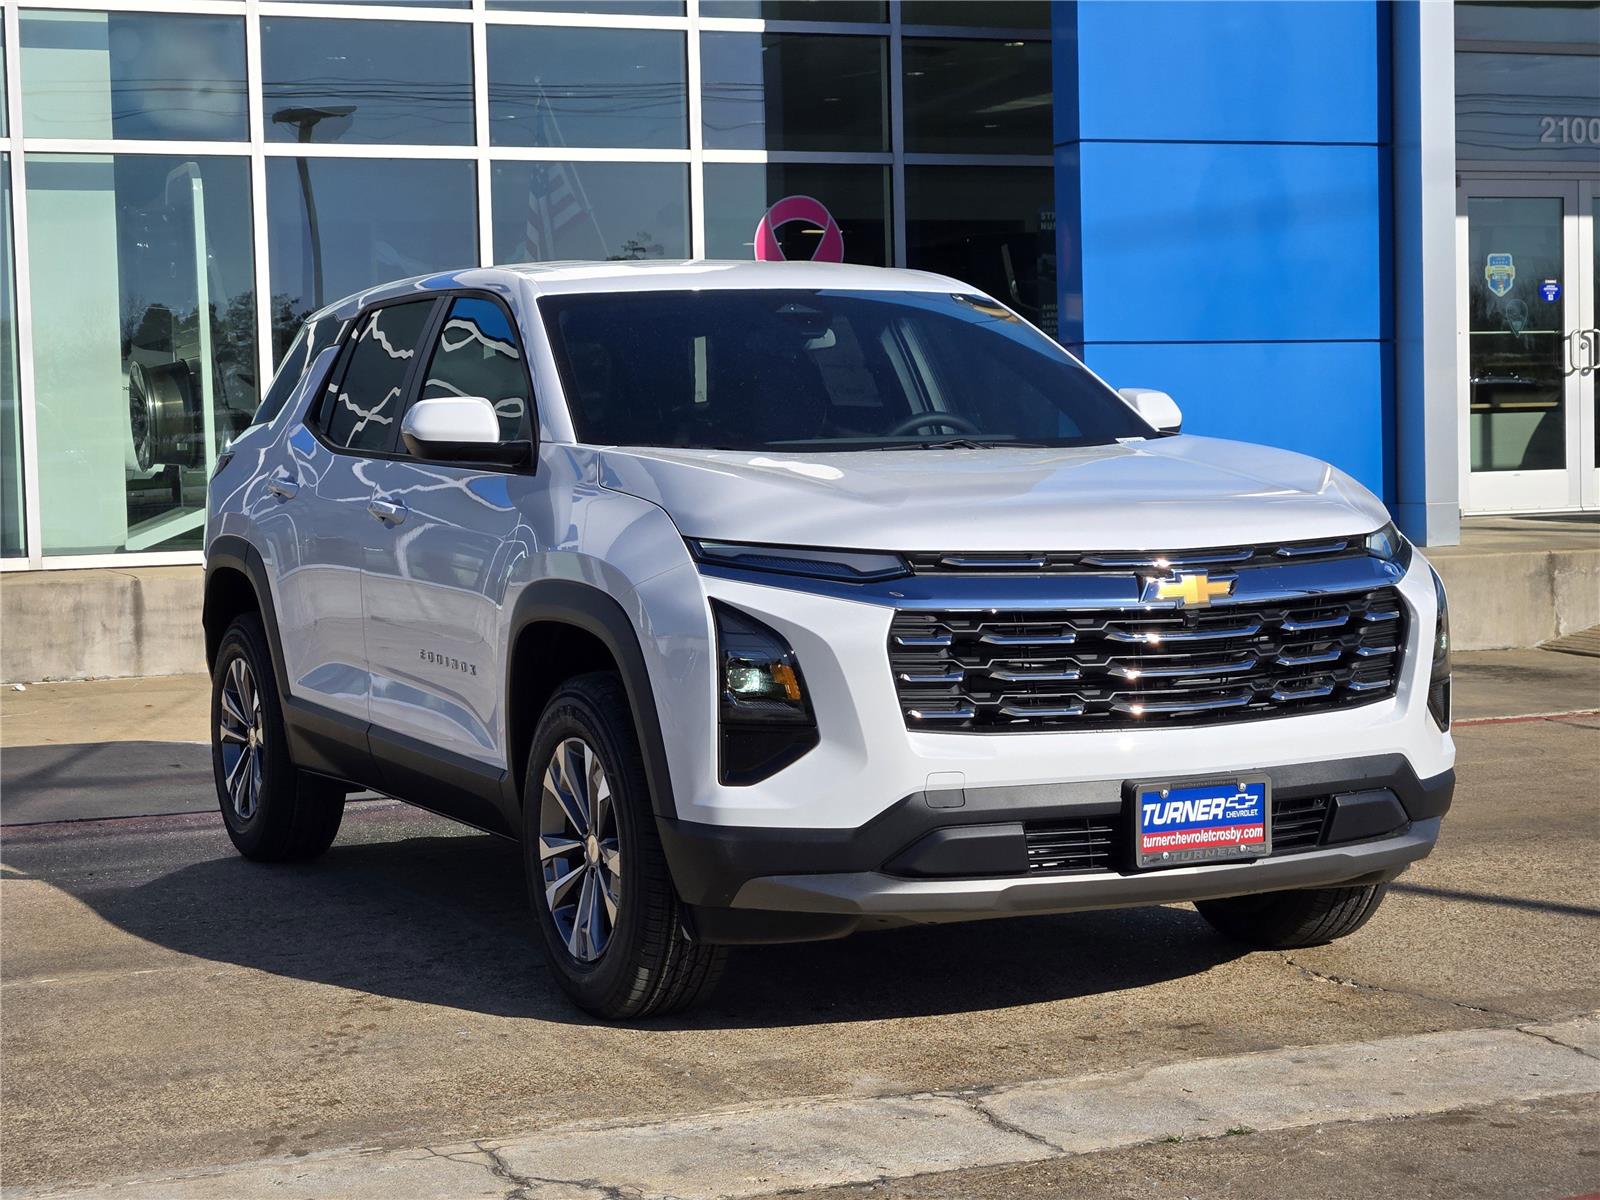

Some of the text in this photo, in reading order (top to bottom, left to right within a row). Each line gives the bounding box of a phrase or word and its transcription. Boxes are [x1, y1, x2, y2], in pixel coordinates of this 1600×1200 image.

[1541, 116, 1600, 144] 2100
[419, 648, 477, 676] EQUINOX
[1143, 798, 1227, 826] TURNER
[1226, 808, 1259, 819] CHEVROLET
[1143, 826, 1264, 848] turnerchevroletcrosby.com
[1171, 848, 1239, 862] TURNER
